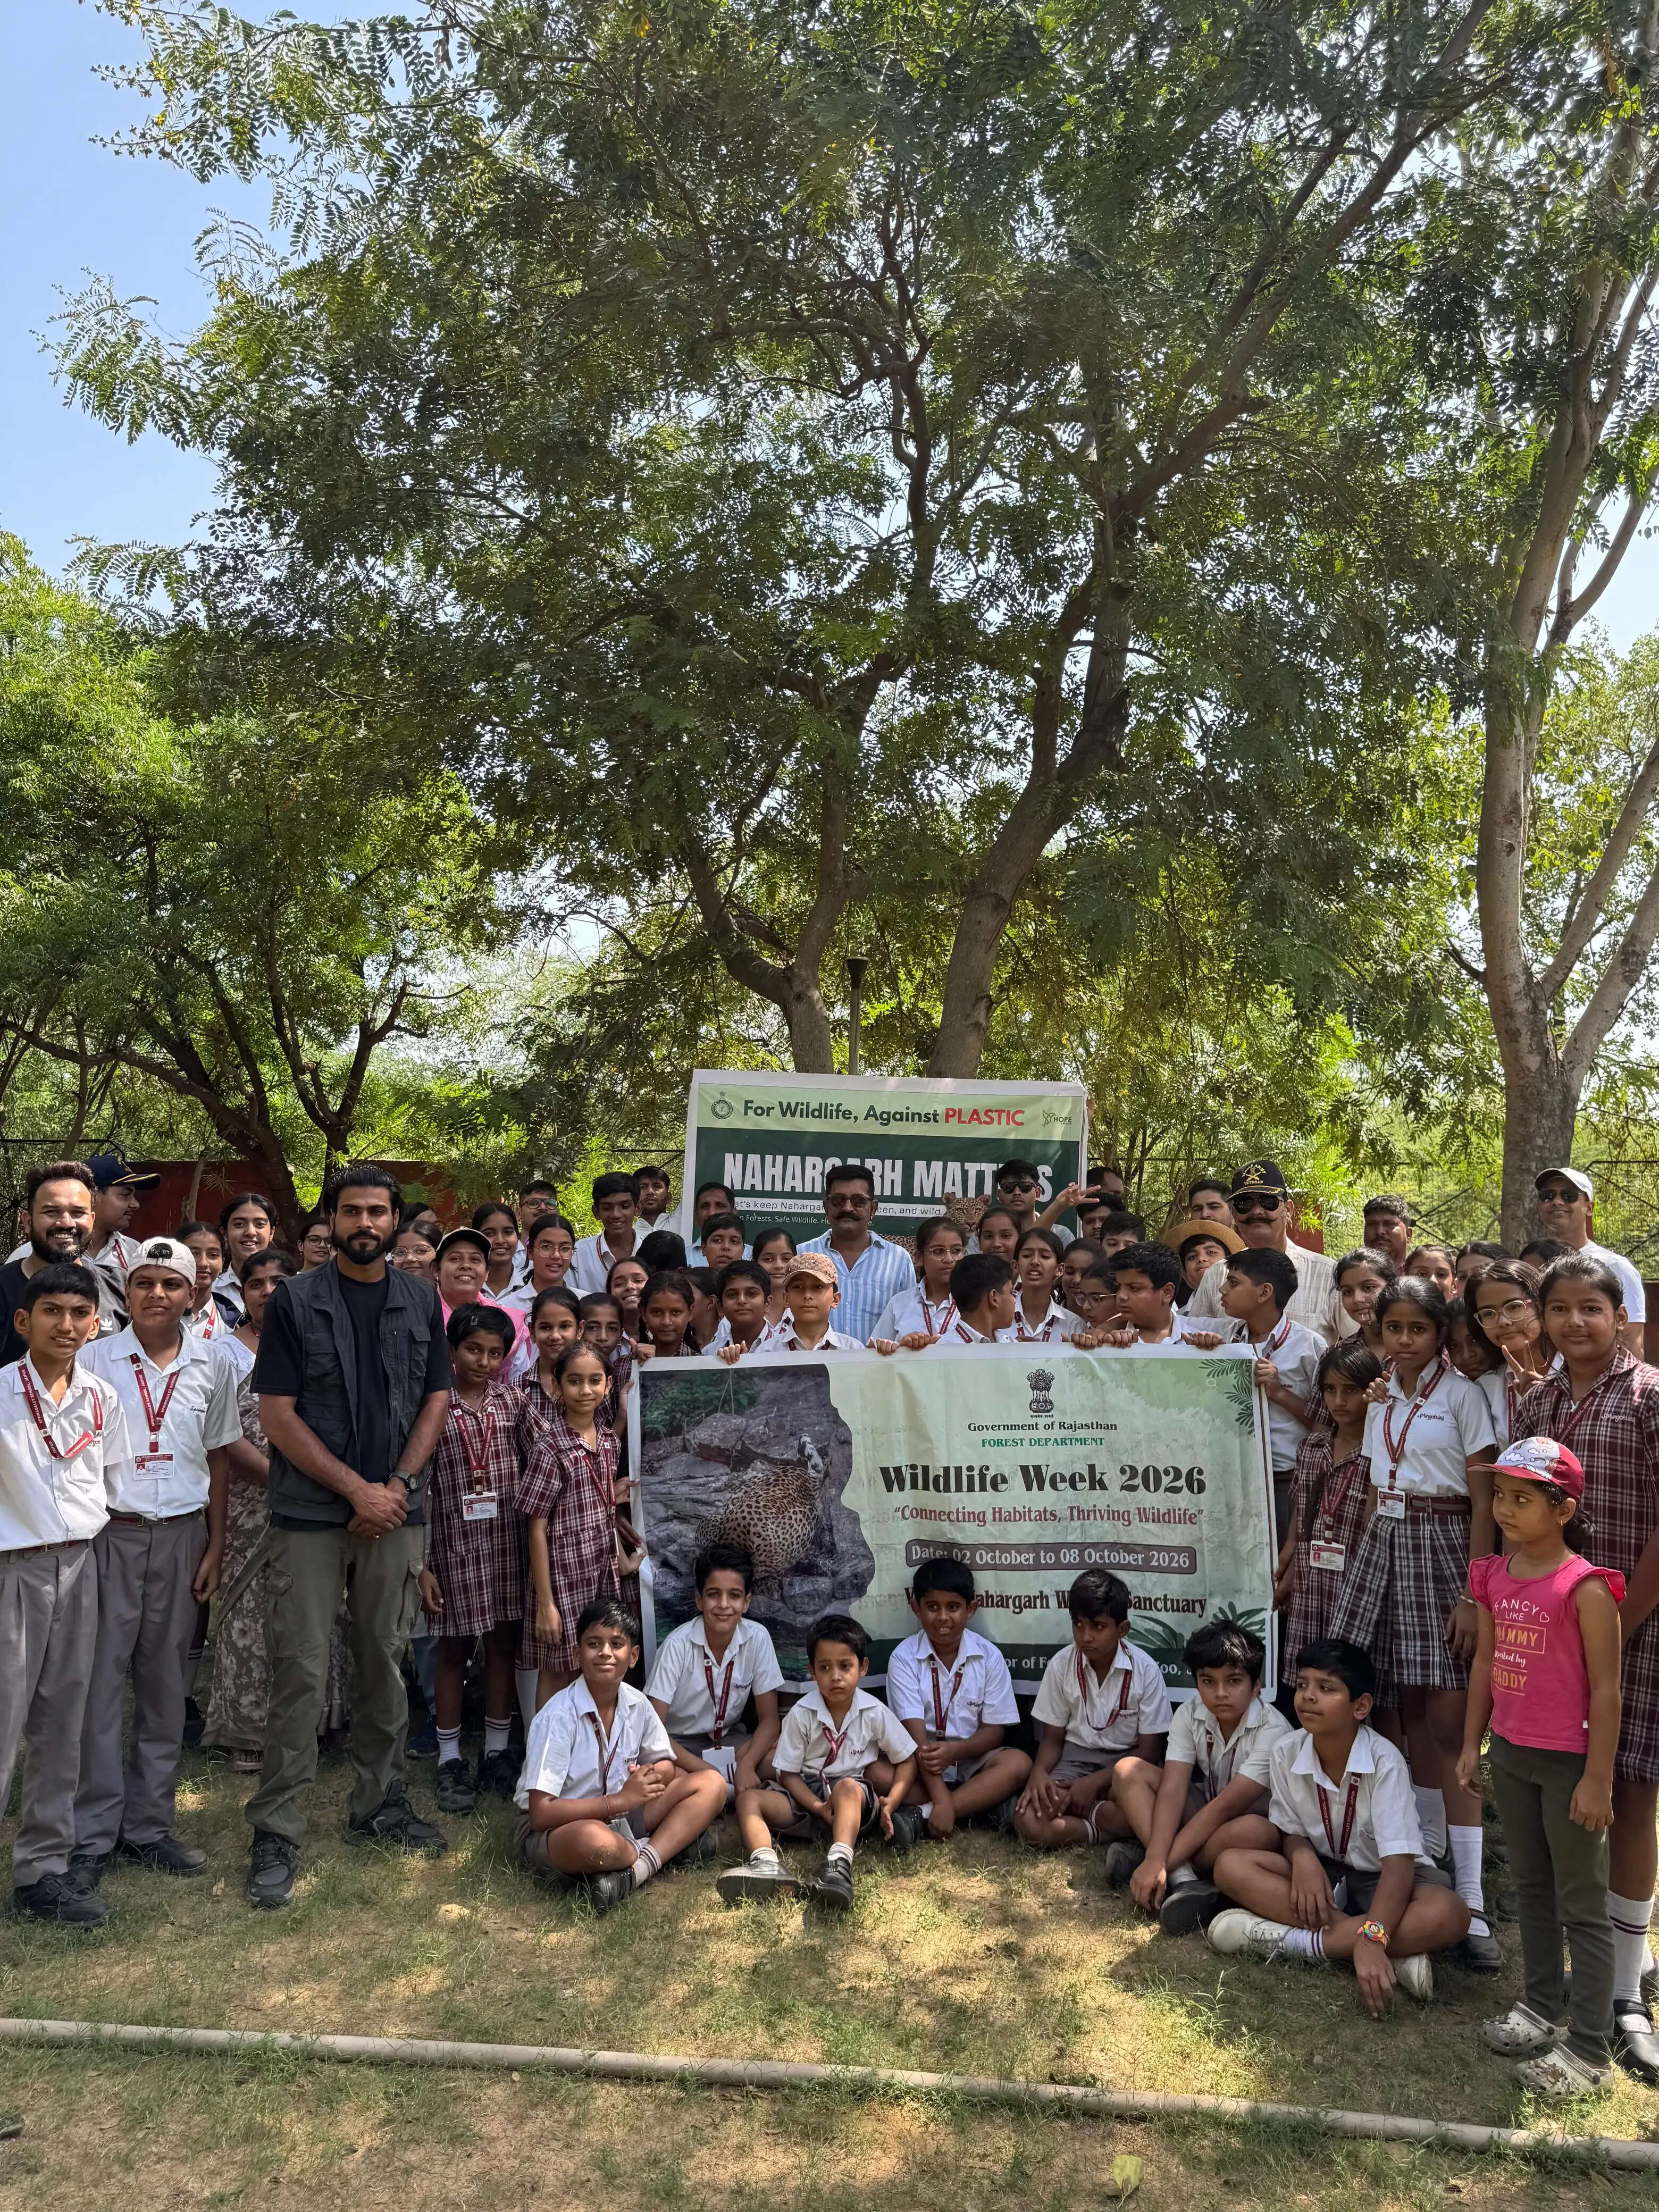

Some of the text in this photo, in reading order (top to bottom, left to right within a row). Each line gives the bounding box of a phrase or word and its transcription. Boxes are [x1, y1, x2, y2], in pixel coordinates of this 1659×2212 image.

[744, 1100, 1025, 1126] For Wildlife, Against PLASTIC
[914, 1160, 1053, 1202] MATTS
[754, 1201, 777, 1210] keep
[746, 1213, 773, 1222] Forests.
[968, 1420, 1117, 1432] Government of Rajasthan
[982, 1437, 1105, 1447] FOREST DEPARTMENT
[879, 1463, 1206, 1495] Wildlife Week 2026
[992, 1506, 1061, 1523] Habitats,
[1067, 1504, 1132, 1527] Thriving
[912, 1545, 1189, 1568] Date: 02 October to 08 October 2026
[977, 1590, 1050, 1614] ahargarh
[1495, 1599, 1539, 1615] FANCY
[1505, 1611, 1524, 1621] LIKE
[1021, 1656, 1036, 1669] of
[1157, 1661, 1182, 1675] oo,
[1515, 1654, 1526, 1668] by
[1493, 1667, 1527, 1690] DADDY
